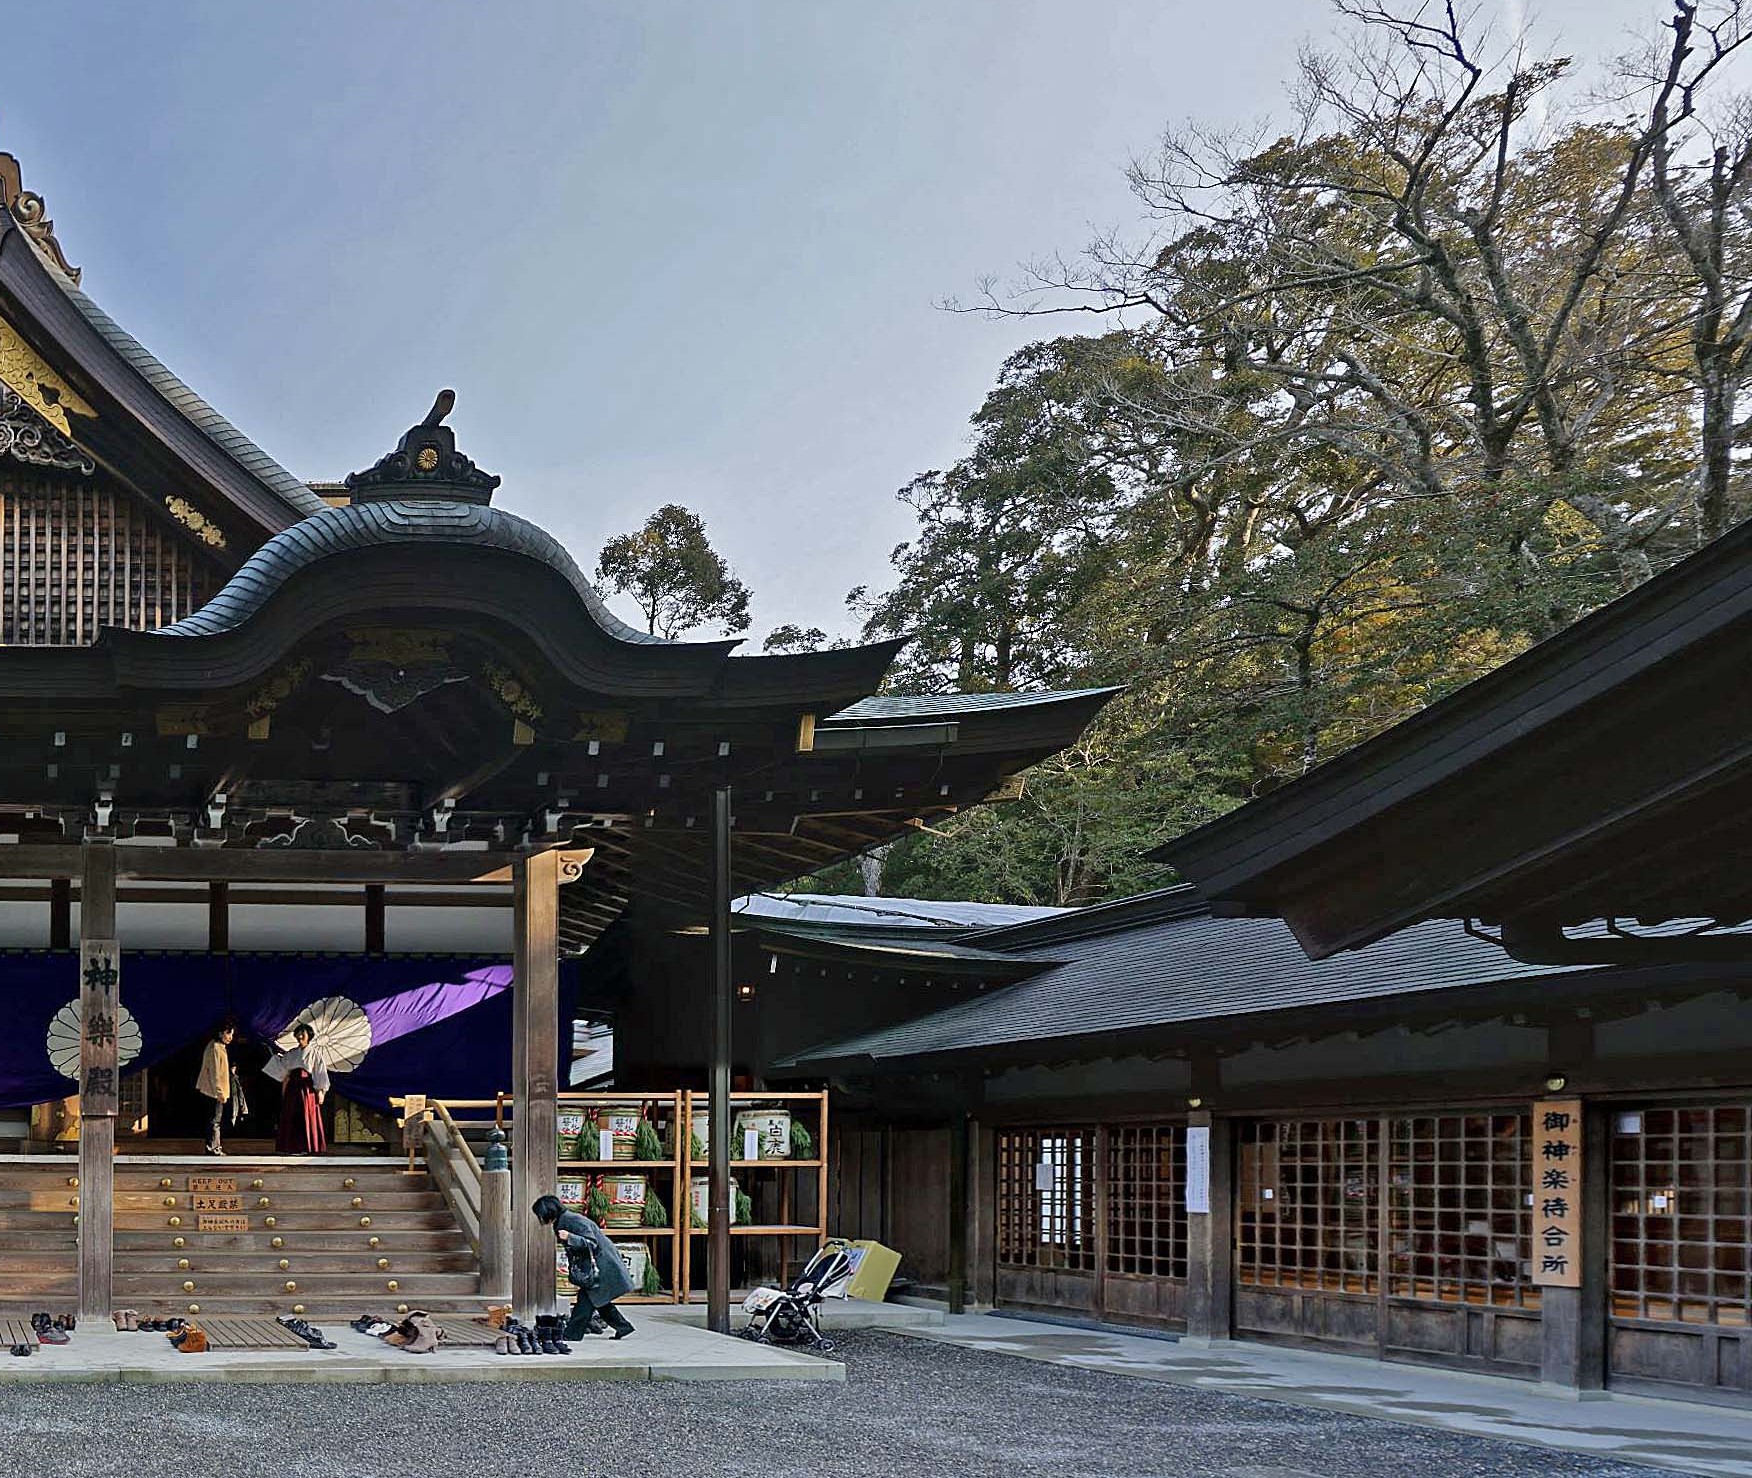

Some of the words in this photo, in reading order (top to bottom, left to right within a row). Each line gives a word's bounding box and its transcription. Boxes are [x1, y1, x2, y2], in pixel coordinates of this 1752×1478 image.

[765, 1125, 785, 1155] 白鹿
[196, 1200, 238, 1209] 土足厳禁
[1542, 1111, 1570, 1275] 御神楽待合所
